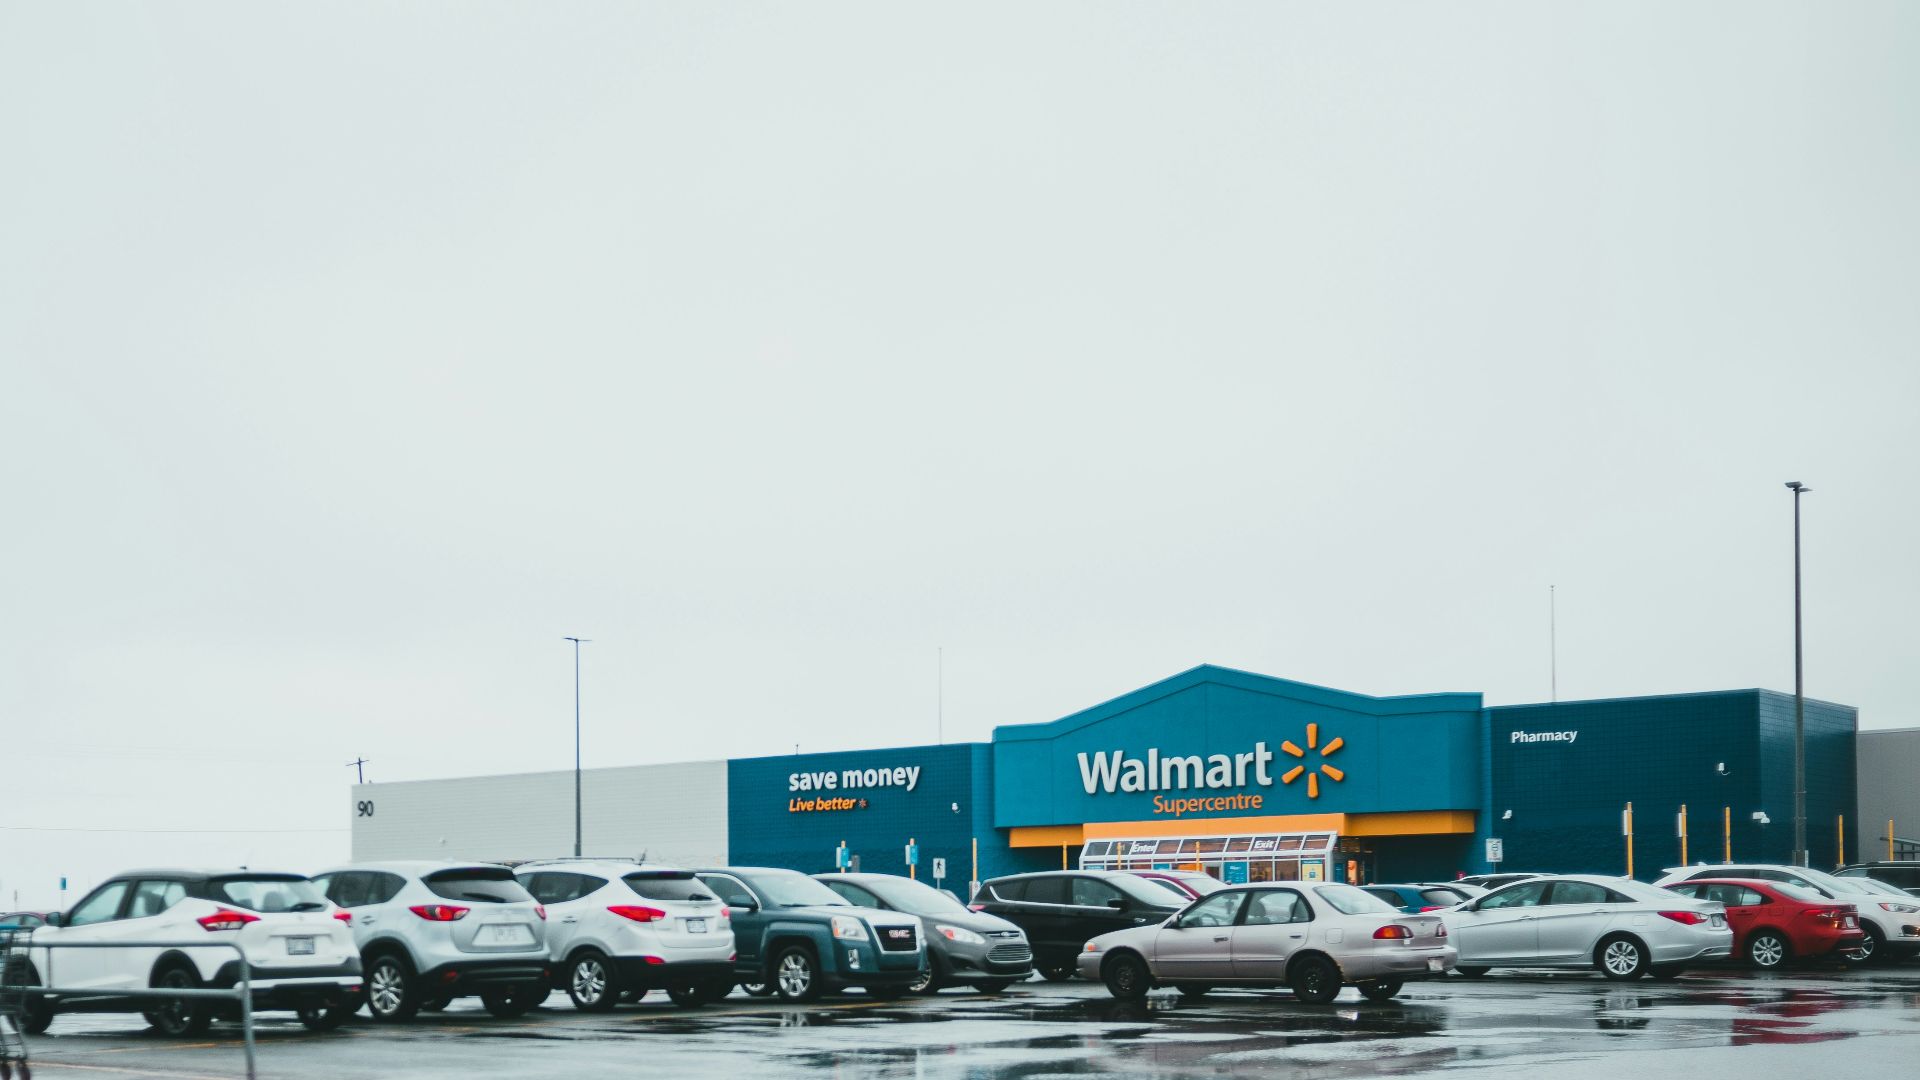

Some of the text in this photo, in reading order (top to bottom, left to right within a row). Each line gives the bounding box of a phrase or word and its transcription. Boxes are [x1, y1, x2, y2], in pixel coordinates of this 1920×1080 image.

[1511, 731, 1578, 743] Pharmacy
[1077, 741, 1272, 794] Walmart
[789, 766, 920, 791] save money
[357, 800, 374, 817] 90
[789, 797, 856, 812] Live better
[1153, 793, 1263, 816] Supercentre
[1132, 844, 1156, 853] Enter
[1254, 840, 1274, 848] Exit
